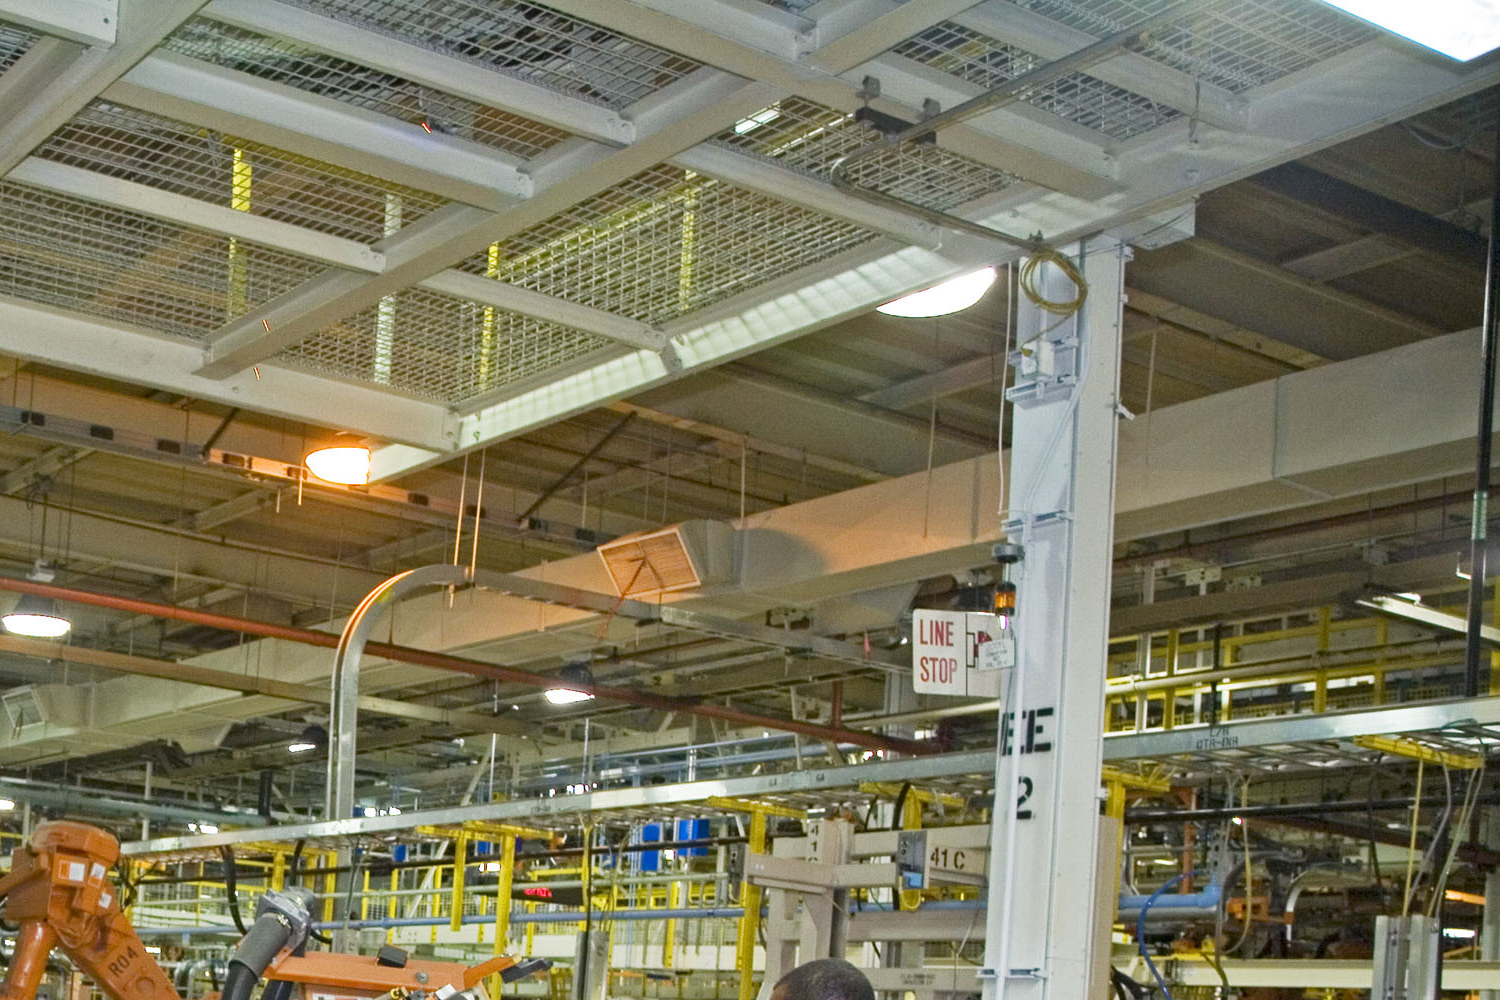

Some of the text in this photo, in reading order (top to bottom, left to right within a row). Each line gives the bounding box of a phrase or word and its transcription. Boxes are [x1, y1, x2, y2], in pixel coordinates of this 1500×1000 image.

[920, 619, 954, 646] LINE
[920, 656, 957, 683] STOP
[1016, 776, 1033, 820] 2
[931, 847, 965, 870] 41 C
[109, 946, 138, 977] R04
